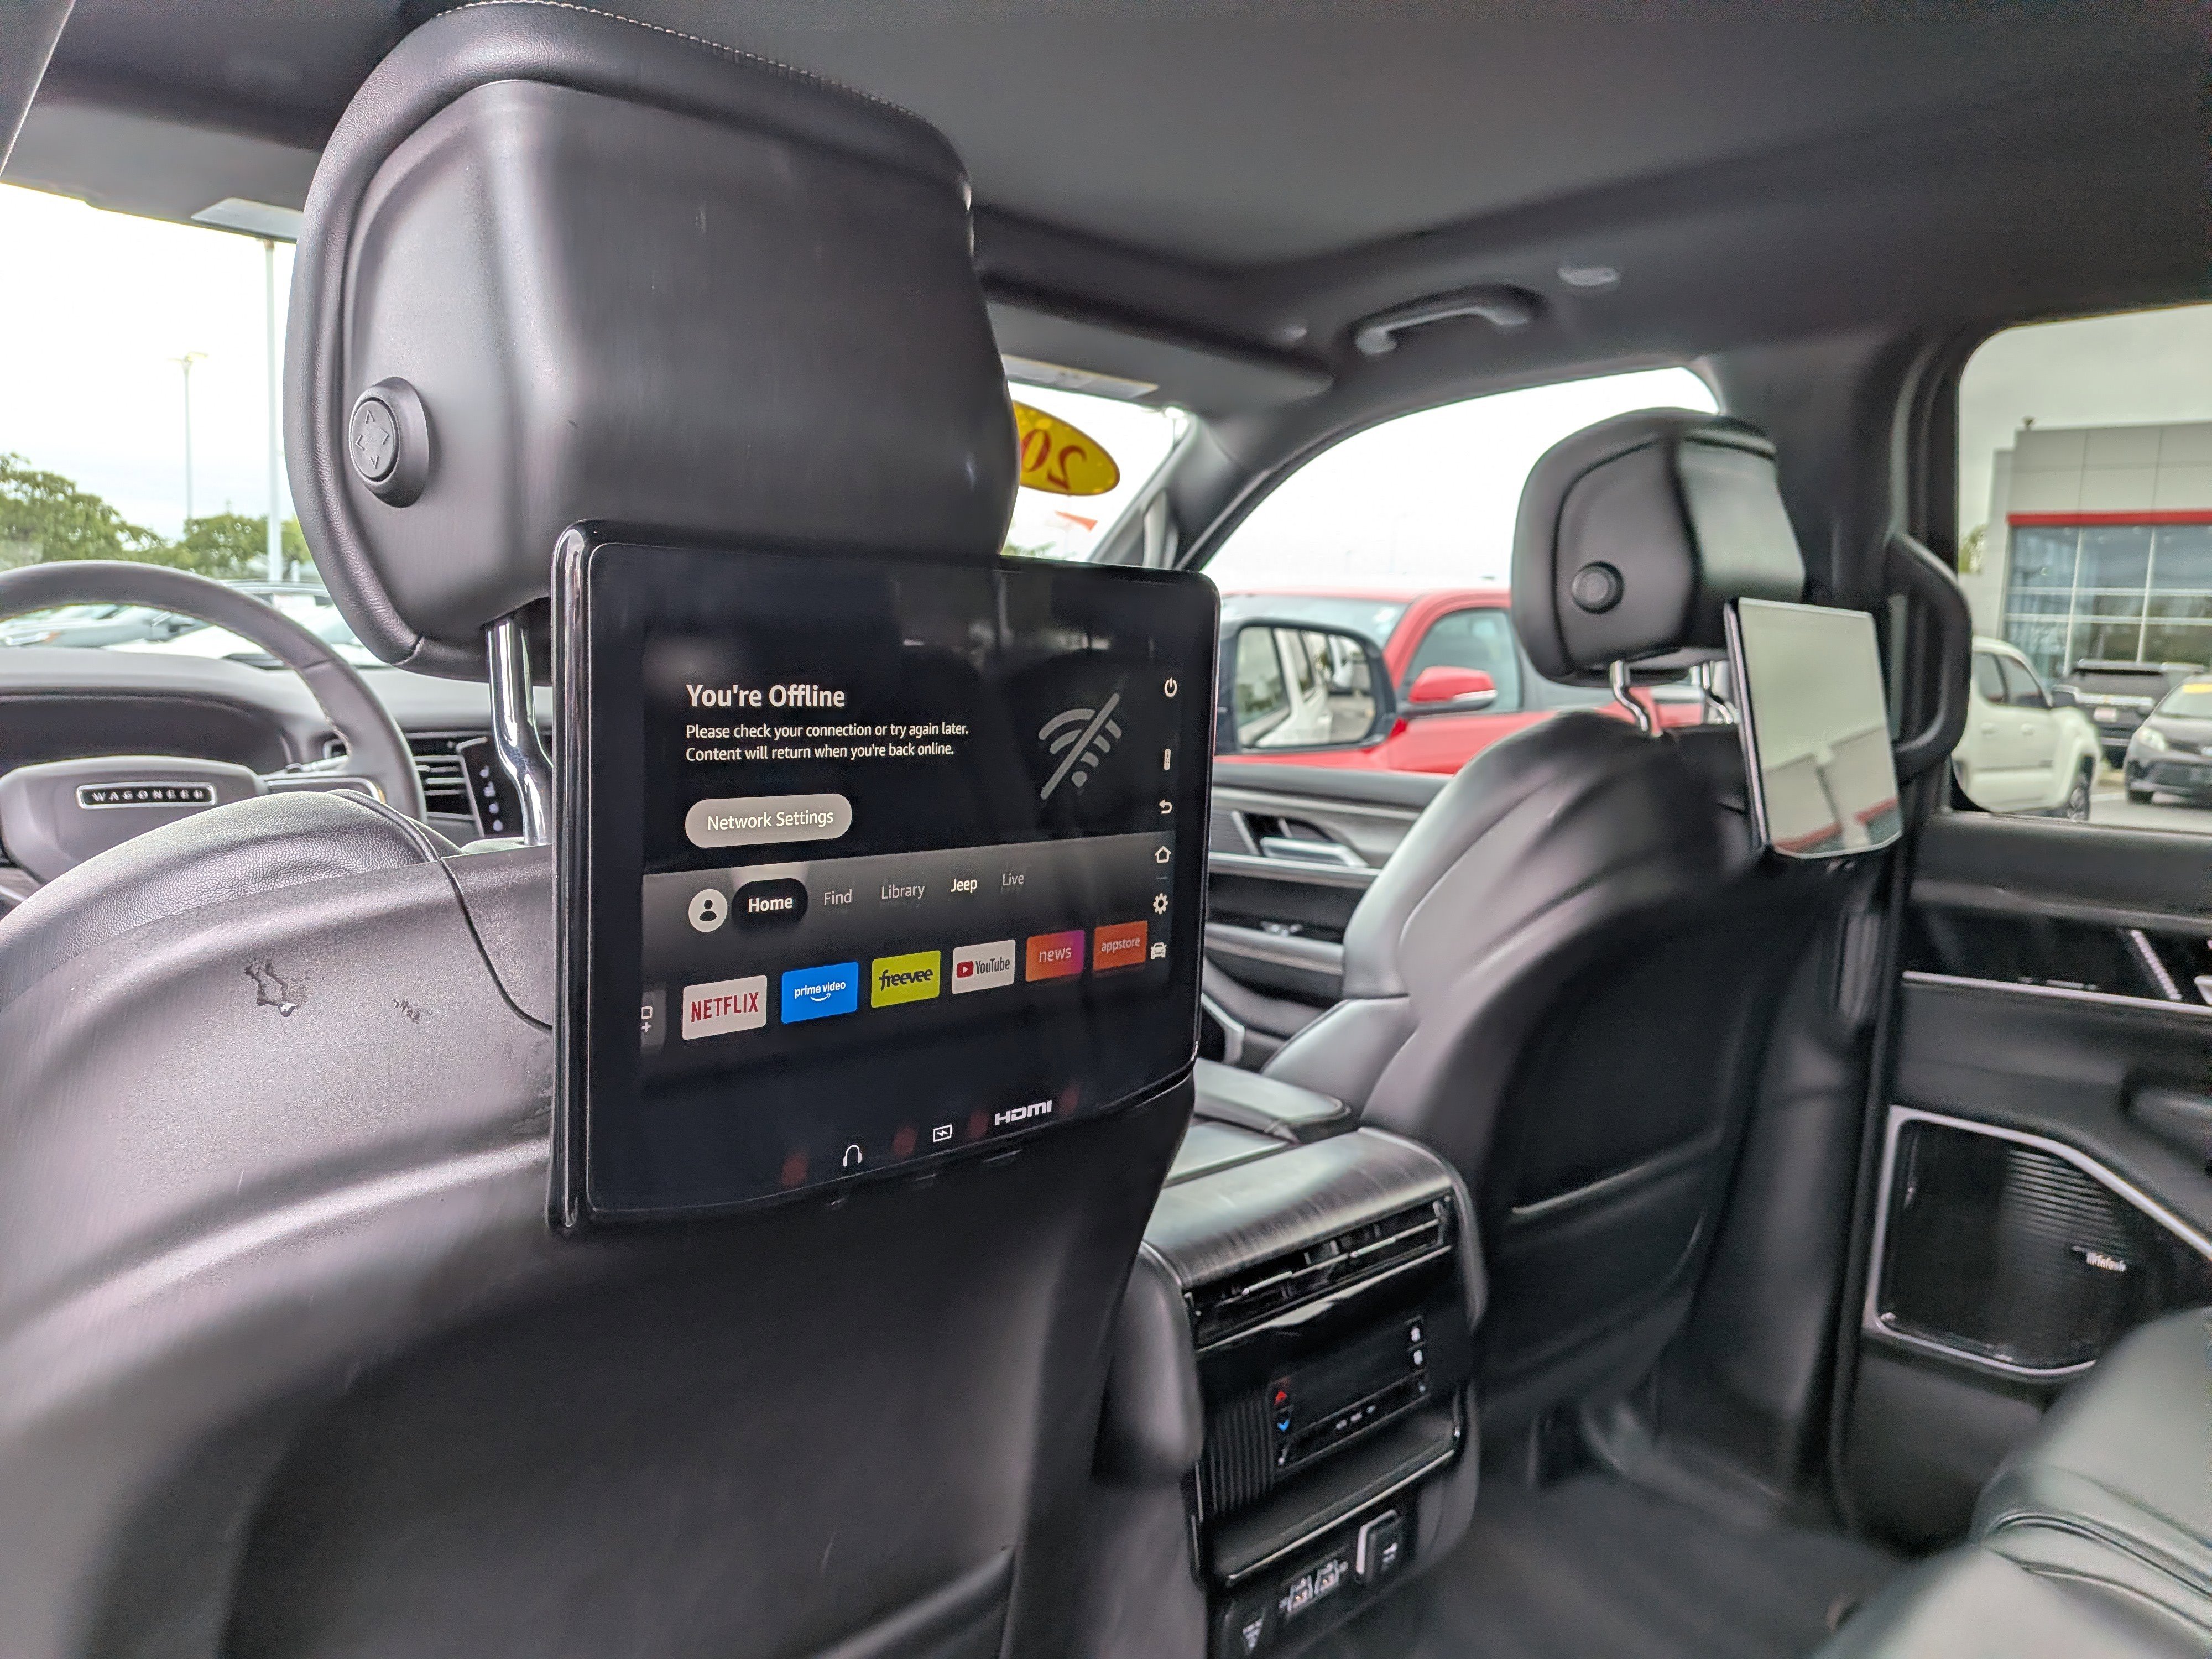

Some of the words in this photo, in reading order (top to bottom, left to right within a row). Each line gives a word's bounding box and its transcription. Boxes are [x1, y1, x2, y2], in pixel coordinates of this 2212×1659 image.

[686, 684, 762, 707] You're
[769, 684, 845, 707] Offline
[686, 724, 731, 739] Please
[733, 723, 771, 738] check
[774, 726, 803, 740] your
[806, 723, 872, 737] connection
[875, 725, 887, 735] or
[890, 723, 907, 739] try
[909, 722, 939, 738] again
[941, 722, 969, 734] later.
[686, 747, 742, 761] Content
[744, 745, 768, 759] will
[771, 747, 811, 759] return
[814, 744, 848, 758] when
[850, 743, 886, 760] you're
[888, 742, 915, 756] back
[917, 742, 954, 755] online.
[707, 811, 772, 831] Network
[776, 810, 834, 828] Settings
[950, 878, 978, 894] Jeep
[1002, 872, 1025, 886] Live
[823, 888, 853, 906] Find
[881, 883, 926, 900] Library
[747, 896, 794, 913] Home
[1100, 937, 1141, 954] appstore
[1039, 946, 1072, 964] news
[975, 957, 1010, 975] YouTube
[878, 968, 933, 992] freevee
[794, 985, 822, 1000] prime
[822, 981, 847, 992] video
[691, 992, 759, 1024] NETFLIX
[994, 1100, 1052, 1126] HDMI
